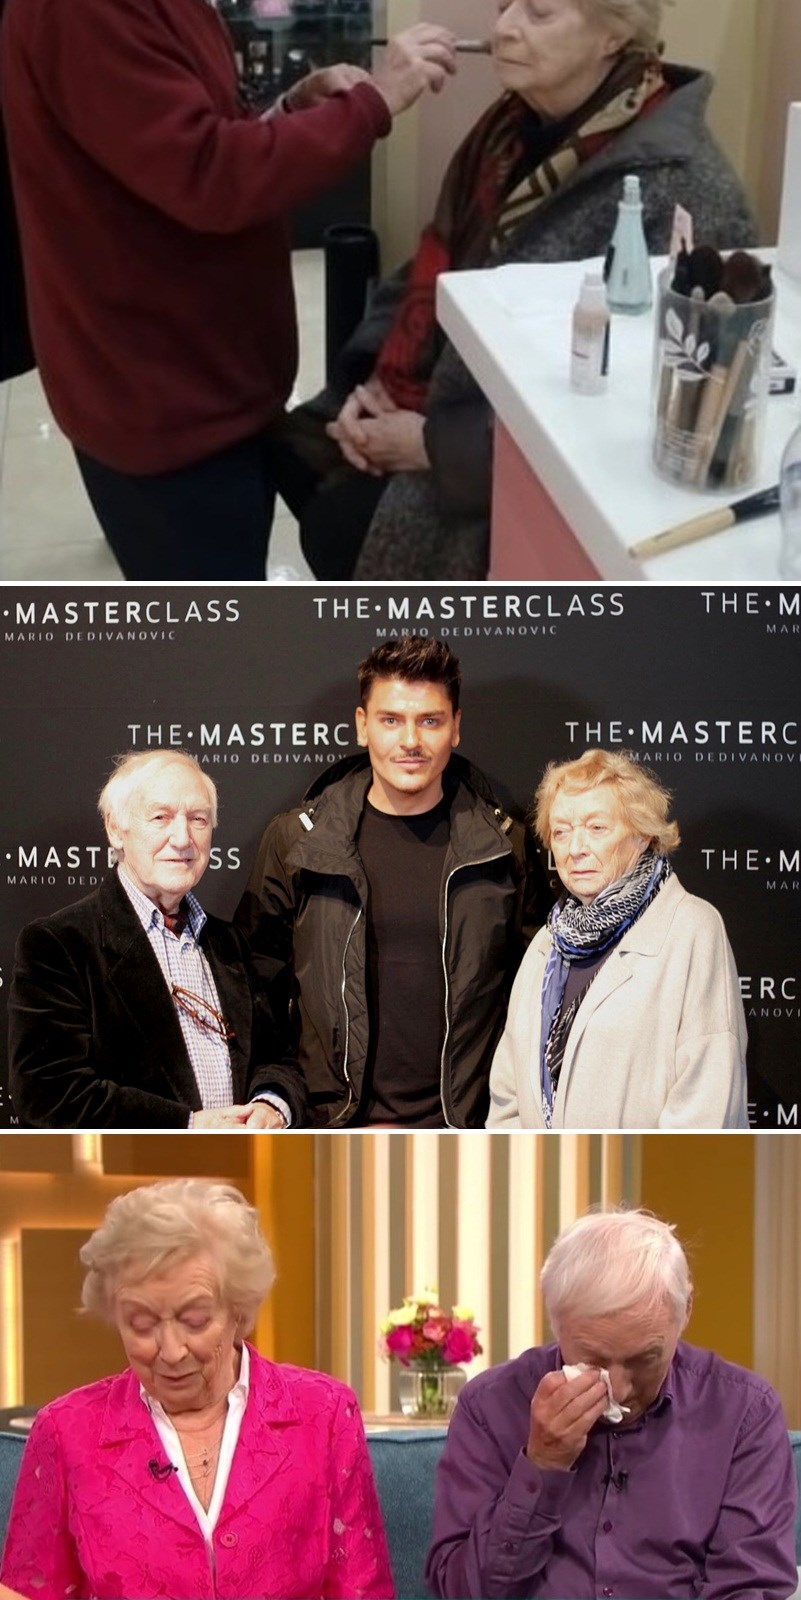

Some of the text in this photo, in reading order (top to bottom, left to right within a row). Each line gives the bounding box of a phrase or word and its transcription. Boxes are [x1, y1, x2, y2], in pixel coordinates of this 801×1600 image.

[4, 630, 176, 642] MARIO DEDIVANOVIC
[376, 625, 557, 638] MARIO DEDIVANOVIC
[628, 752, 682, 762] MARIO
[7, 876, 56, 885] MARIO
